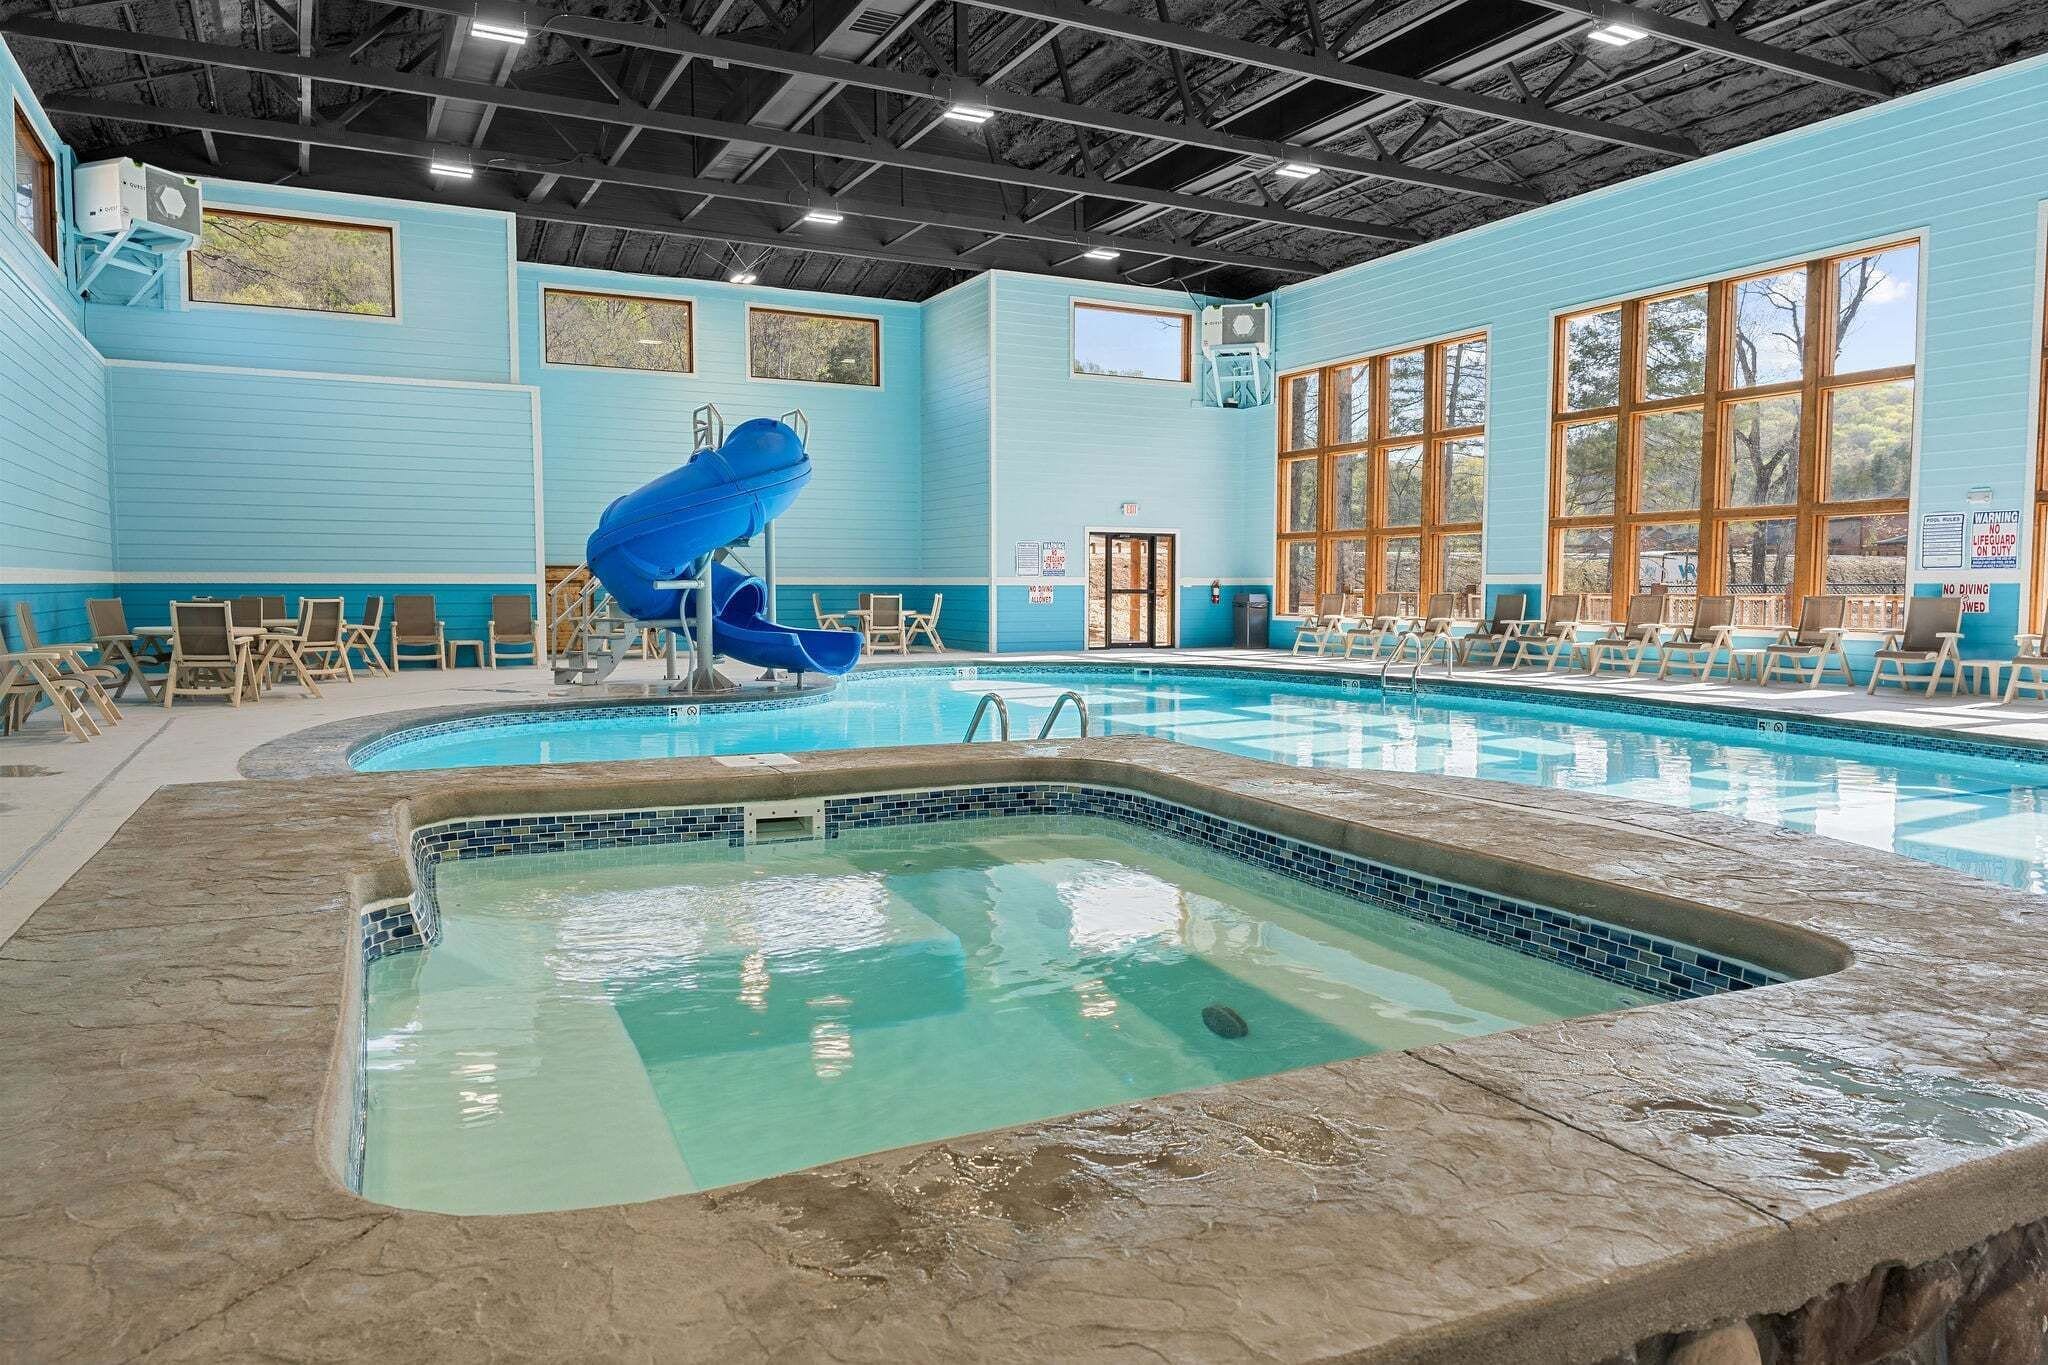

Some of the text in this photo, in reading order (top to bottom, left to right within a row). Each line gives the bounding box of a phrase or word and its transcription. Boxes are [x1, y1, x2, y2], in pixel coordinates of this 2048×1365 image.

[1975, 511, 2018, 524] WARNING
[1989, 524, 2001, 534] NO
[1973, 535, 2016, 546] LIFEGUARD
[1977, 546, 2011, 556] ON DUTY
[1943, 584, 1989, 595] NO DIVING
